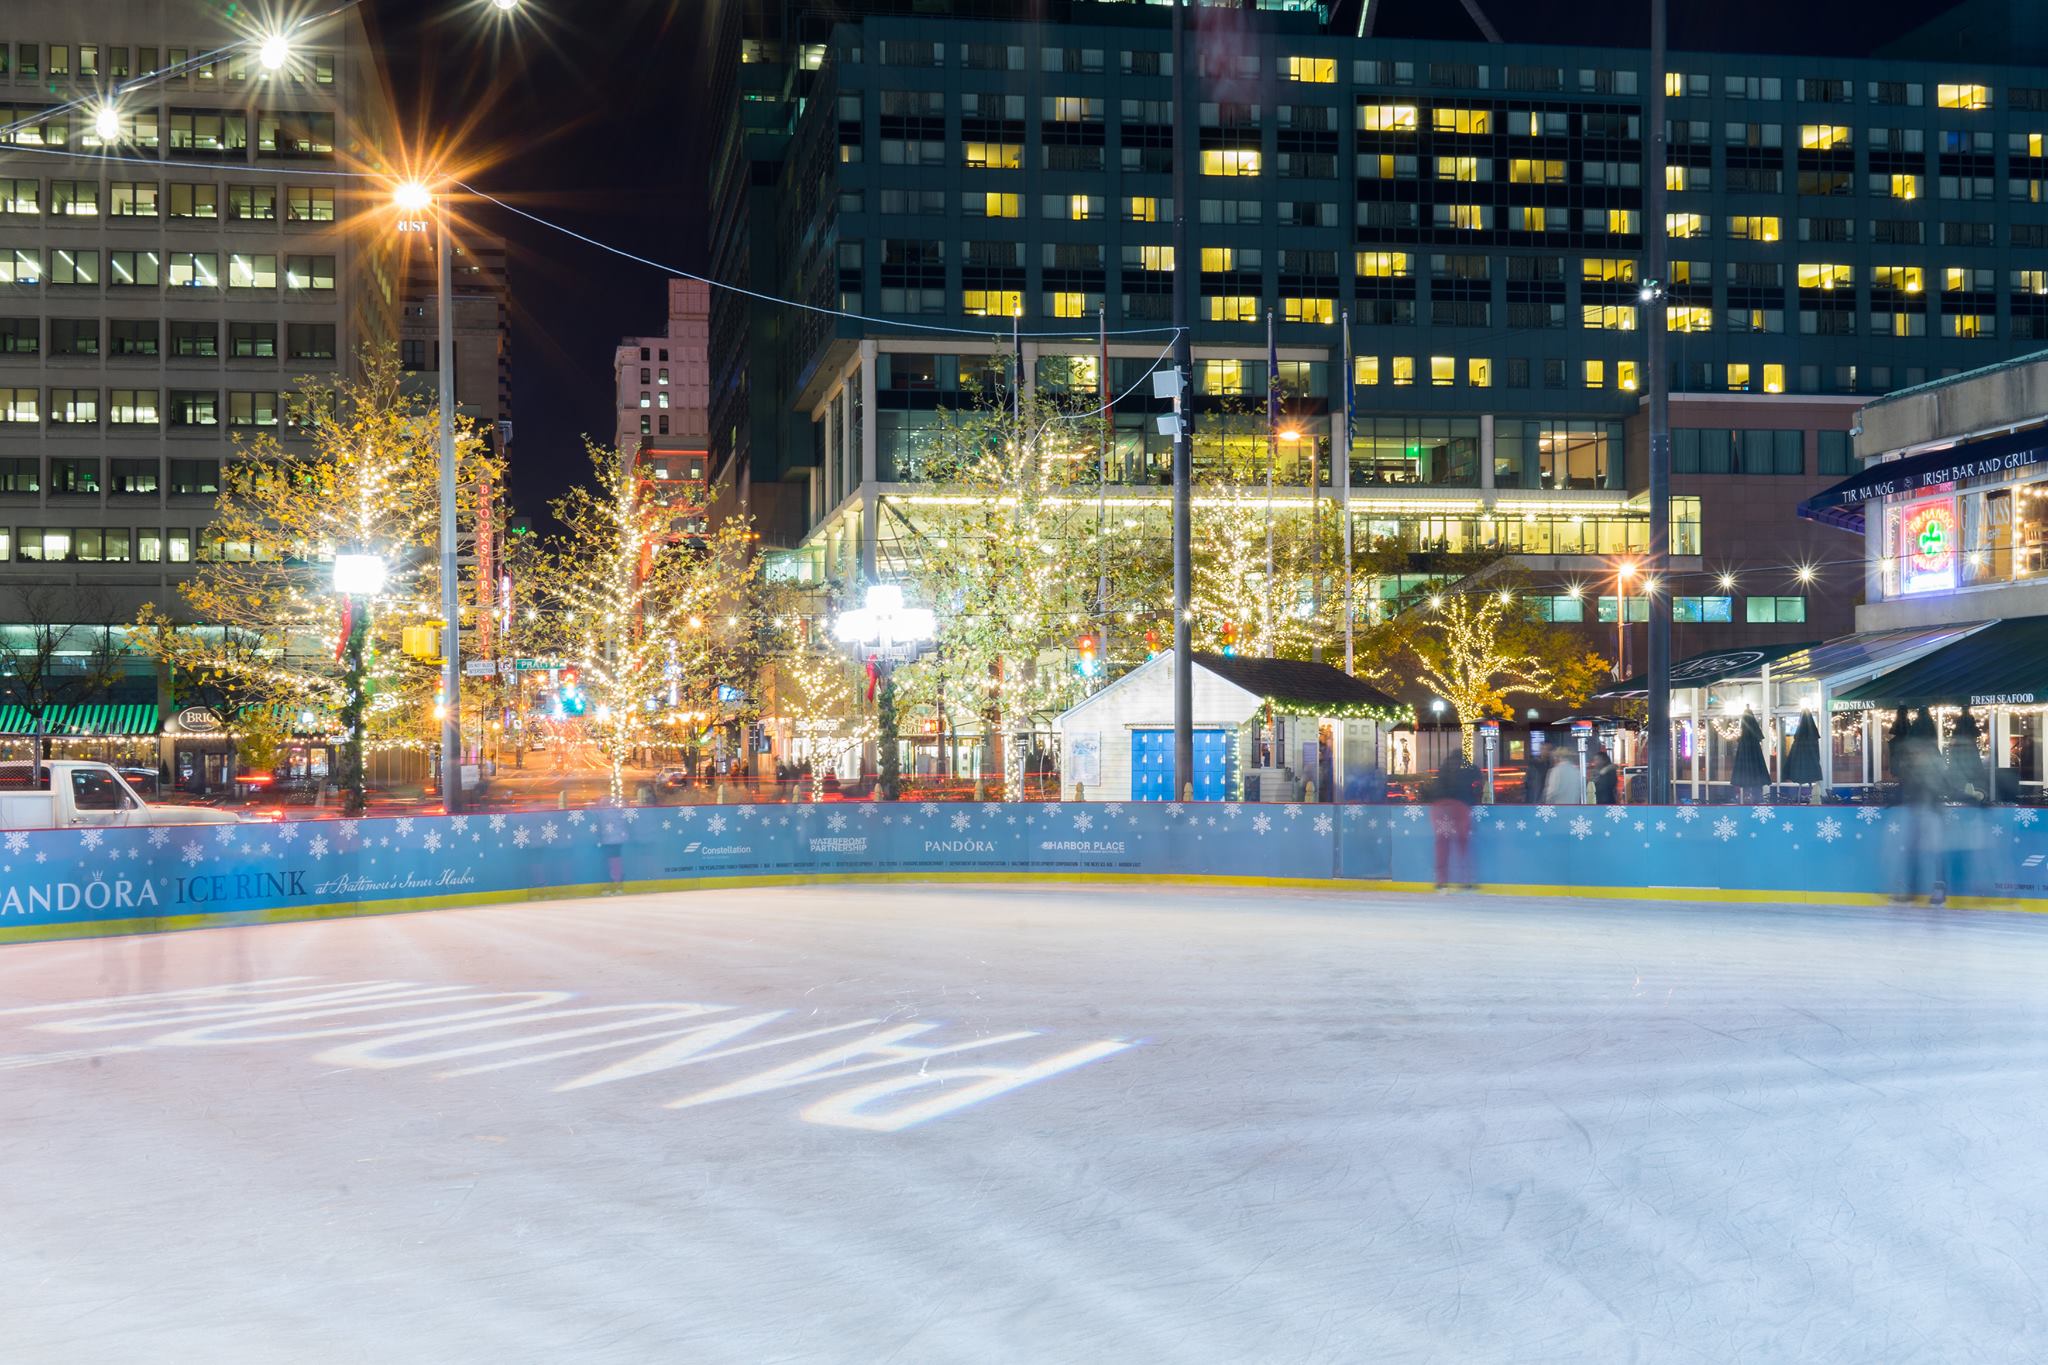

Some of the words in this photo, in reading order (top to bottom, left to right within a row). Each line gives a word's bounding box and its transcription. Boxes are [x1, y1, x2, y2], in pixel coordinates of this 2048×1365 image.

[1923, 468, 1949, 486] IRISH
[1952, 463, 1975, 481] BAR
[1978, 458, 2001, 474] AND
[2004, 449, 2038, 469] GRILL
[1842, 490, 1857, 504] TIR
[1860, 487, 1872, 500] NA
[478, 484, 490, 603] BROOKSHIRE
[1849, 699, 1875, 710] STEAKS
[1971, 694, 1996, 705] FRESH
[1996, 692, 2034, 704] SEAFOOD
[809, 837, 868, 845] WATERFRONT
[924, 839, 994, 852] PANDORA
[1051, 841, 1091, 850] HARBOR
[1093, 841, 1125, 850] PLACE
[701, 845, 752, 855] Constellation
[810, 844, 868, 852] PARTNERSHIP
[0, 876, 159, 916] ANDORA
[175, 875, 228, 904] ICE
[234, 869, 307, 899] RINK
[314, 881, 337, 895] at
[330, 872, 398, 895] Baltimore's
[398, 870, 433, 889] Inner
[435, 866, 476, 887] Harbor
